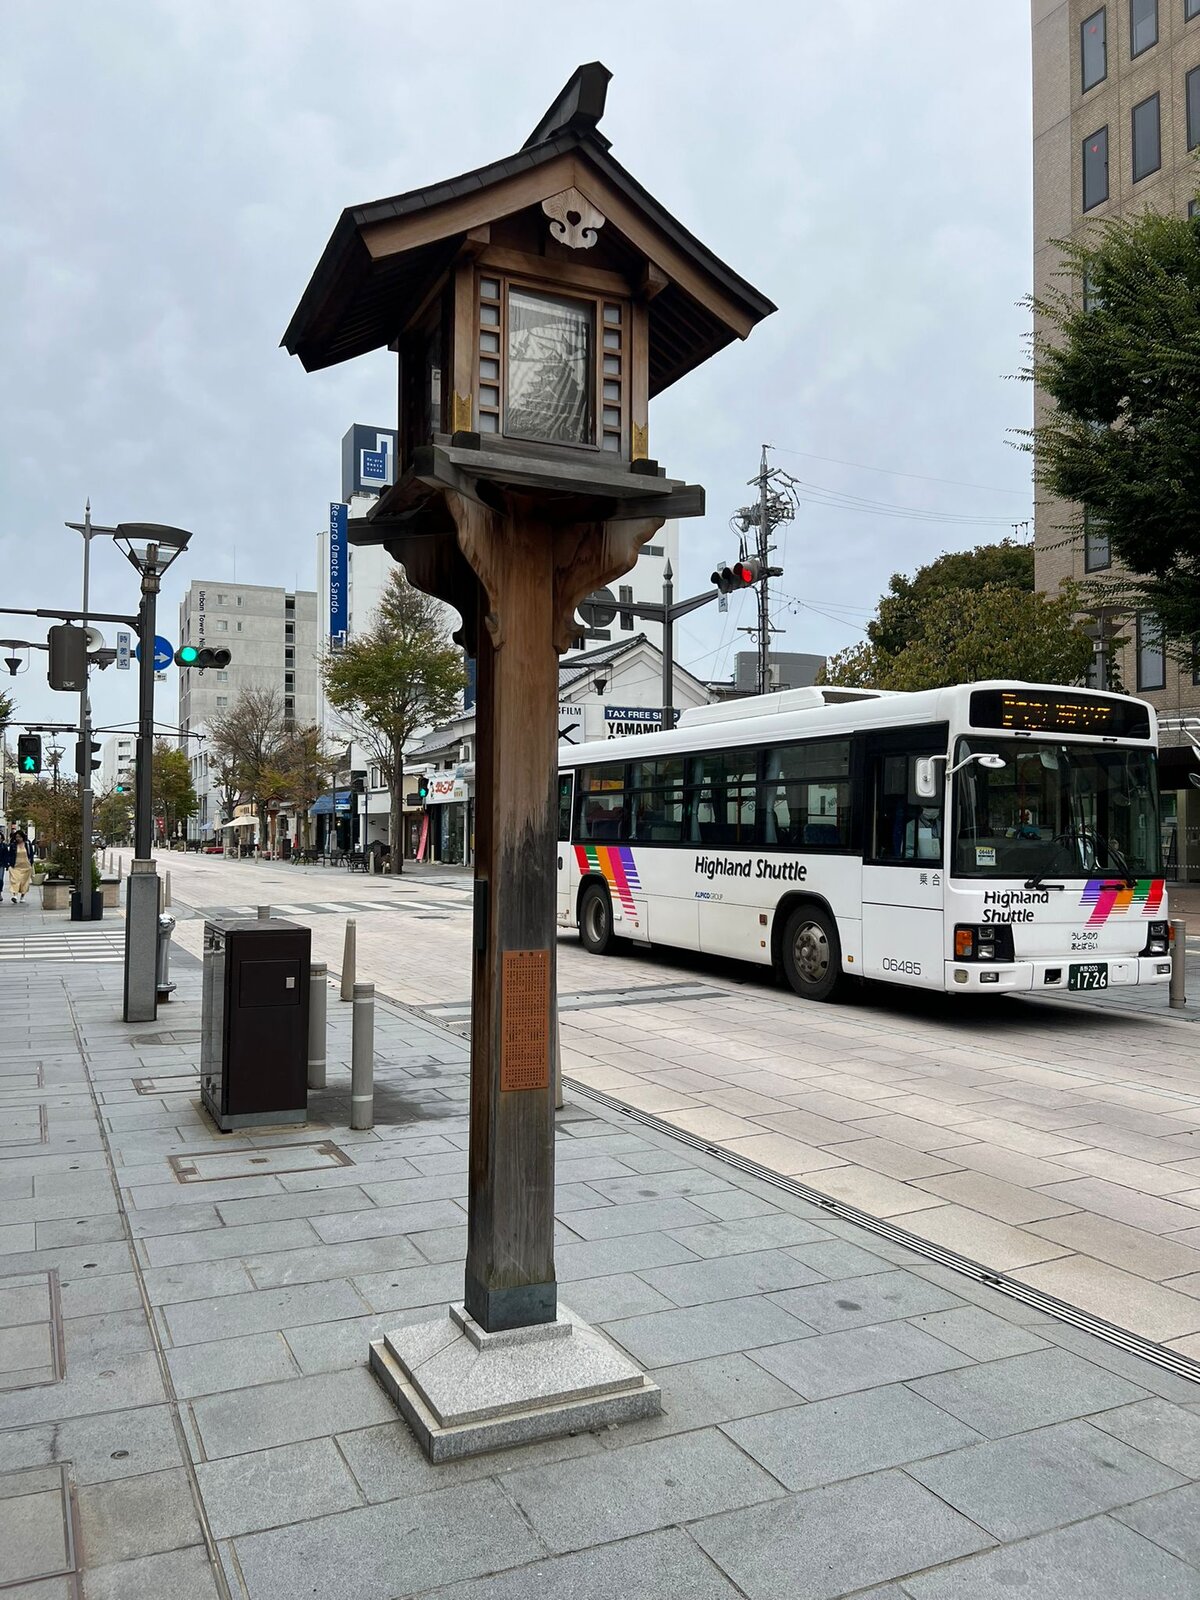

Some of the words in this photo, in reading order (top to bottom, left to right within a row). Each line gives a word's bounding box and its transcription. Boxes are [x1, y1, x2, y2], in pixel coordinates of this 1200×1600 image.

[331, 503, 340, 540] Re-pro
[331, 545, 340, 577] Omote
[198, 590, 206, 611] Urban
[331, 582, 340, 614] Sando
[198, 614, 206, 635] Tower
[608, 709, 626, 718] TAX
[628, 710, 650, 719] FREE
[695, 856, 752, 880] Highland
[755, 859, 808, 881] Shuttle
[983, 890, 1050, 909] Highland
[981, 908, 1035, 923] Shuttle
[1070, 941, 1099, 951] あとばらい
[1071, 931, 1099, 941] うしろのり
[882, 957, 922, 976] 06485
